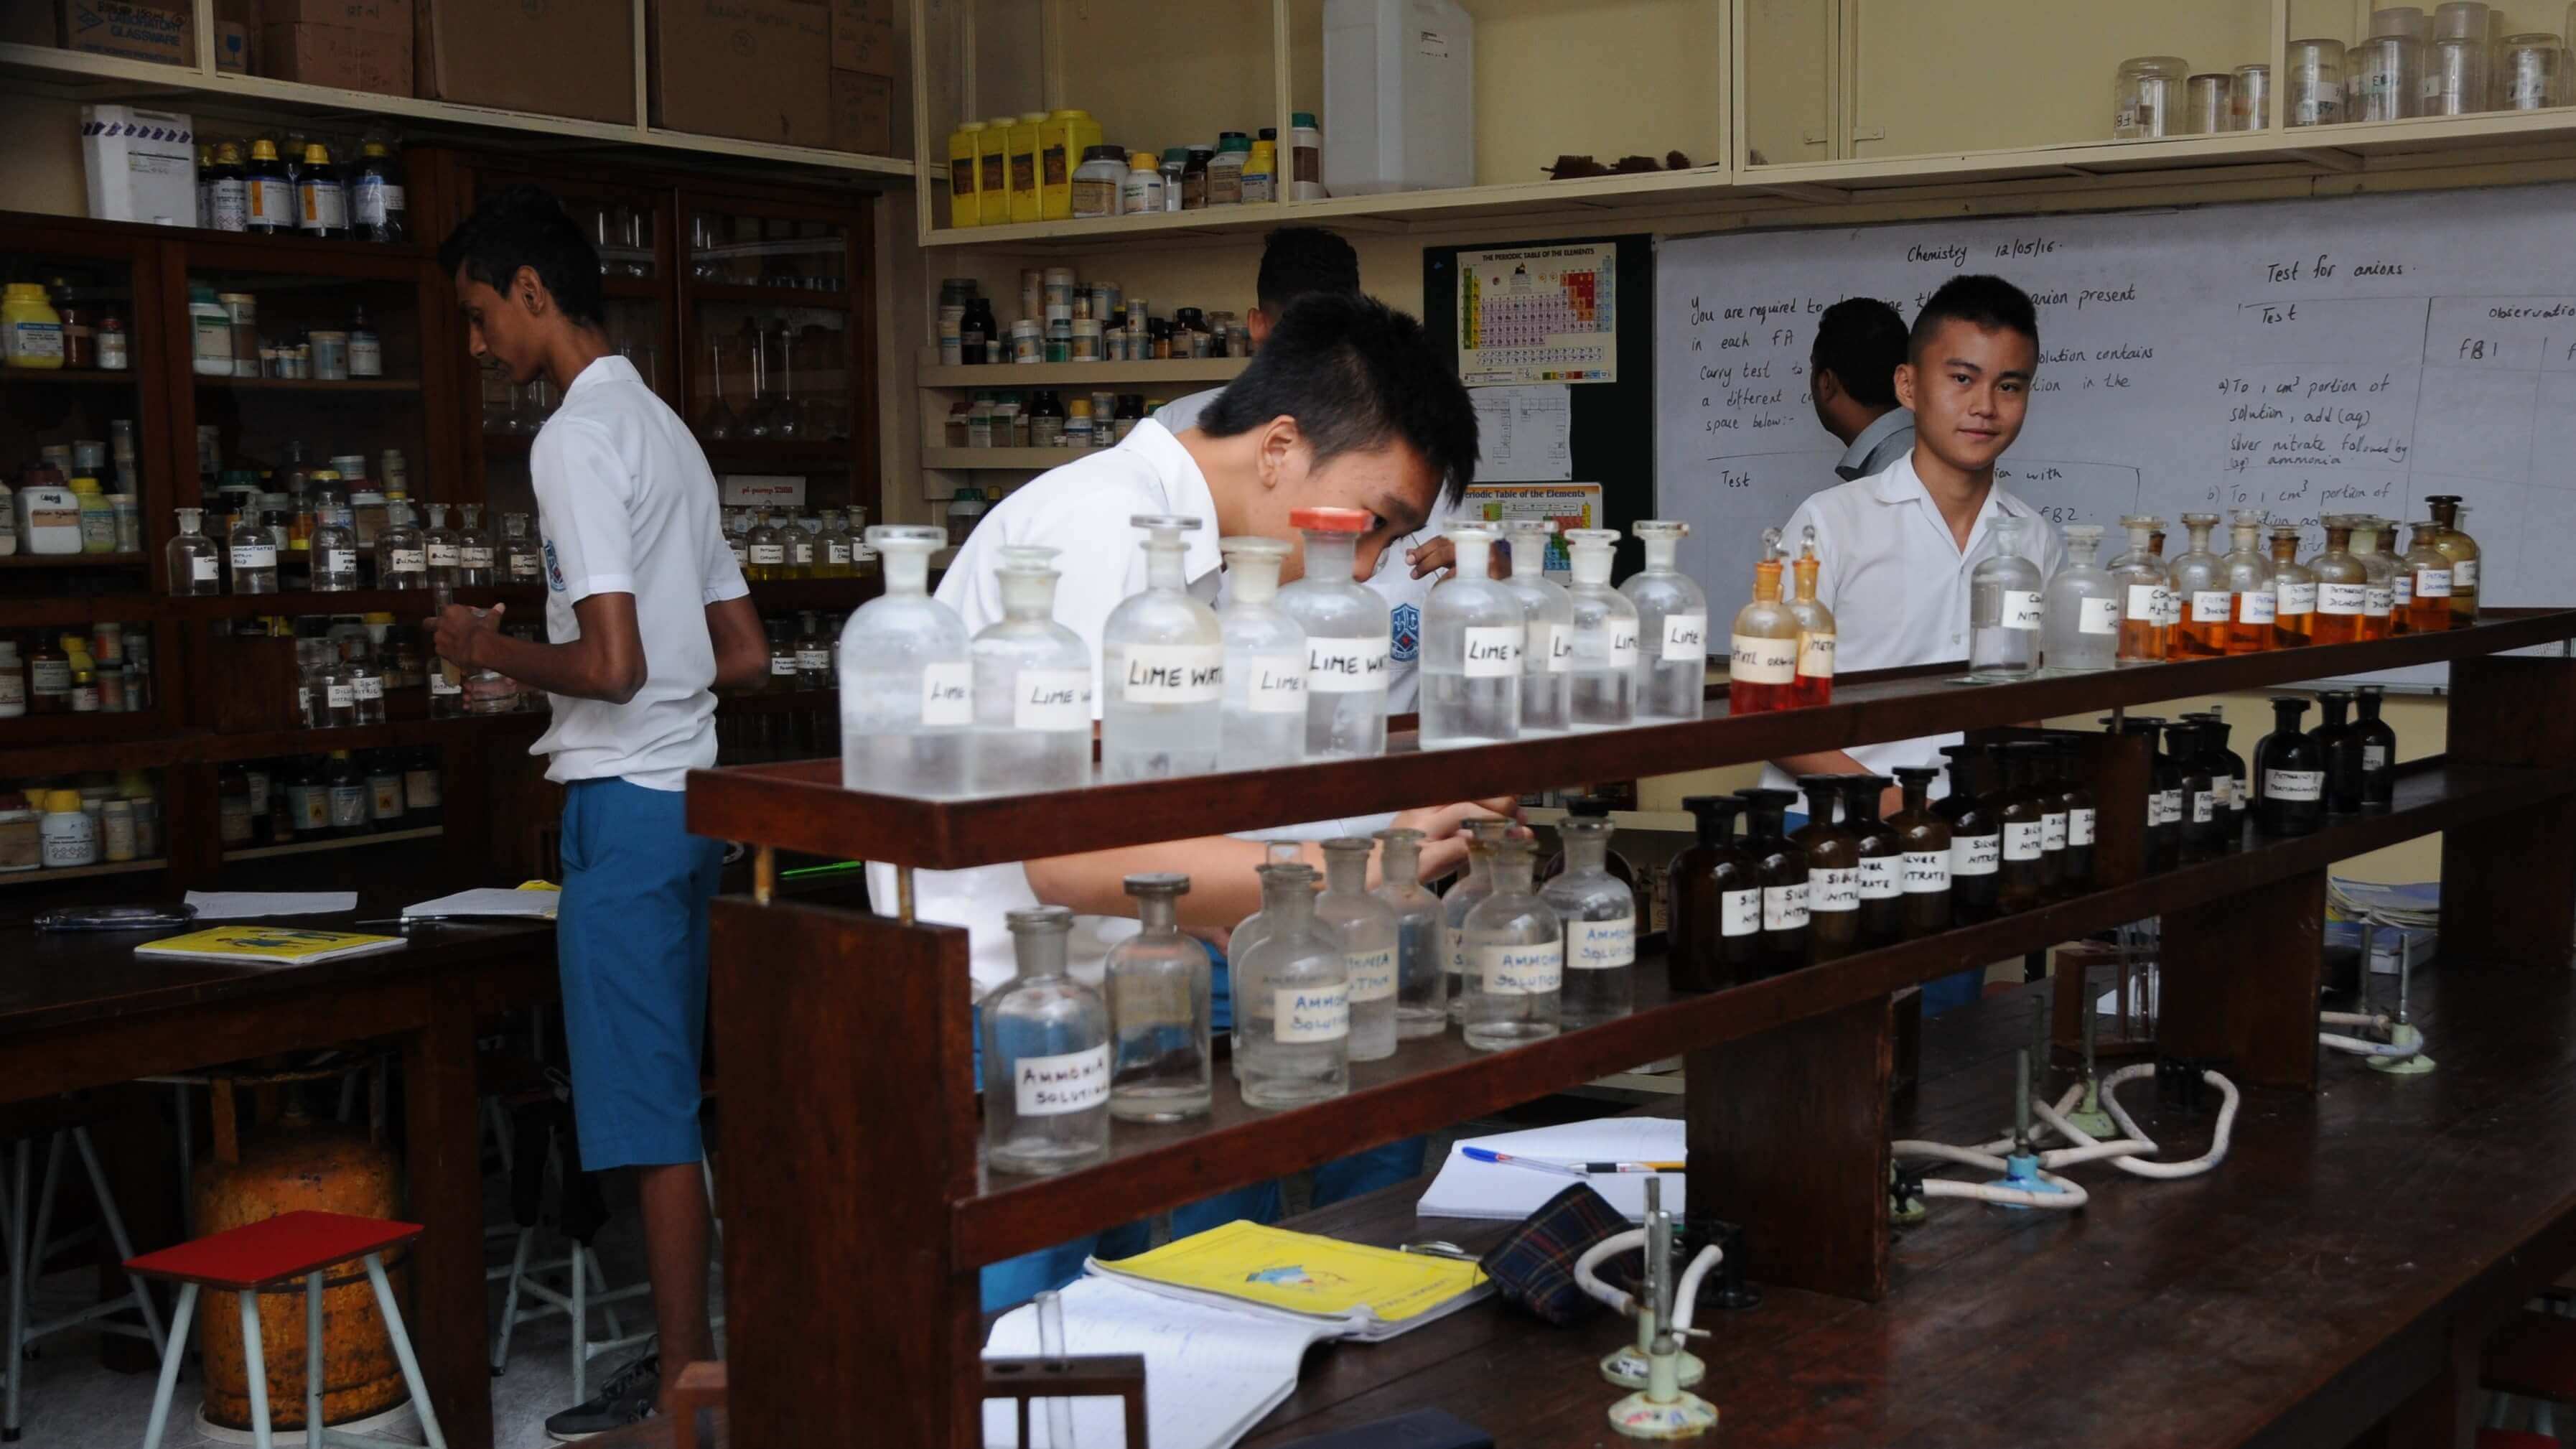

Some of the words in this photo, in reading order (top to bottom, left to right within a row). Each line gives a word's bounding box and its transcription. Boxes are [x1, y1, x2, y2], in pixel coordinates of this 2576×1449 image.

[1523, 251, 1541, 259] TABLE
[1564, 248, 1595, 256] ELEMENTS
[1908, 245, 1966, 267] Chemistry
[2268, 260, 2300, 283] Test
[2314, 254, 2336, 279] for
[1691, 296, 1714, 325] You
[1724, 306, 1744, 319] are
[1750, 299, 1796, 325] required
[1808, 298, 1823, 314] to
[2078, 283, 2136, 310] present
[2262, 303, 2297, 324] Test
[1691, 337, 1702, 351] in
[1721, 332, 1750, 350] each
[1700, 365, 1732, 388] Carry
[1742, 360, 1770, 378] test
[2038, 348, 2086, 364] olution
[2096, 343, 2154, 360] contains
[1702, 397, 1710, 407] a
[1727, 389, 1781, 410] different
[2083, 375, 2094, 390] in
[2104, 373, 2131, 388] the
[2233, 379, 2249, 393] To
[2307, 379, 2357, 399] portion
[2369, 373, 2389, 392] of
[2303, 407, 2332, 423] add
[1705, 417, 1740, 435] space
[2273, 434, 2325, 452] nitrate
[1721, 470, 1750, 488] Test
[2026, 467, 2063, 481] with
[1465, 490, 1493, 499] eriodic
[1519, 490, 1529, 498] of
[1530, 490, 1544, 498] the
[1546, 490, 1585, 498] Elements
[2230, 484, 2246, 502] To
[2320, 483, 2366, 505] portion
[2374, 483, 2391, 498] of
[1470, 640, 1508, 660] LIME
[1310, 649, 1358, 674] LIME
[1128, 659, 1182, 688] LIME
[1261, 671, 1298, 690] LIME
[930, 681, 965, 701] LIME
[1030, 686, 1074, 704] LIME
[1904, 870, 1945, 882] ITRATE
[1022, 1057, 1103, 1085] AMMONIA
